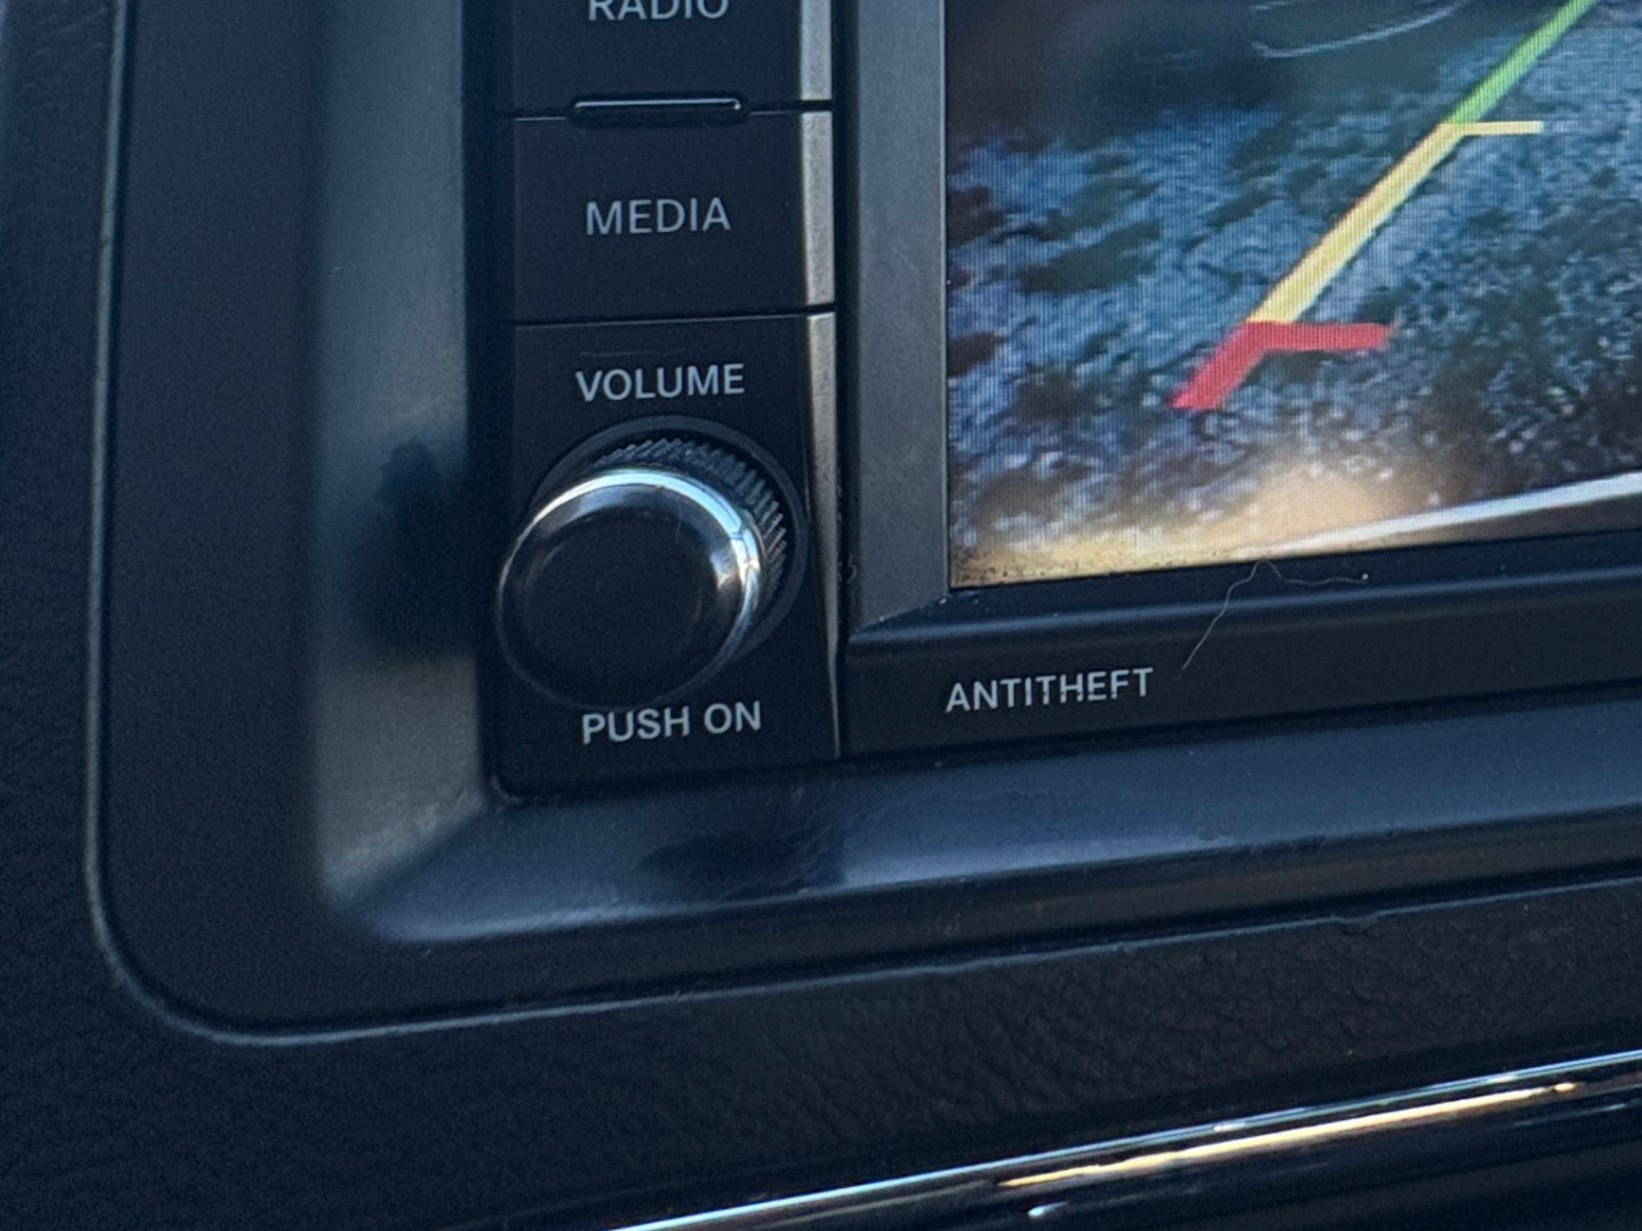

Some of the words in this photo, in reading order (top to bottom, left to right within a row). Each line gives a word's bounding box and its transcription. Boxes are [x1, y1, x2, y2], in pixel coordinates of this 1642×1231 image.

[585, 196, 732, 236] MEDIA
[575, 362, 746, 403] VOLUME
[944, 666, 1154, 713] ANTITHEFT
[581, 705, 691, 745] PUSH
[703, 699, 763, 736] ON
